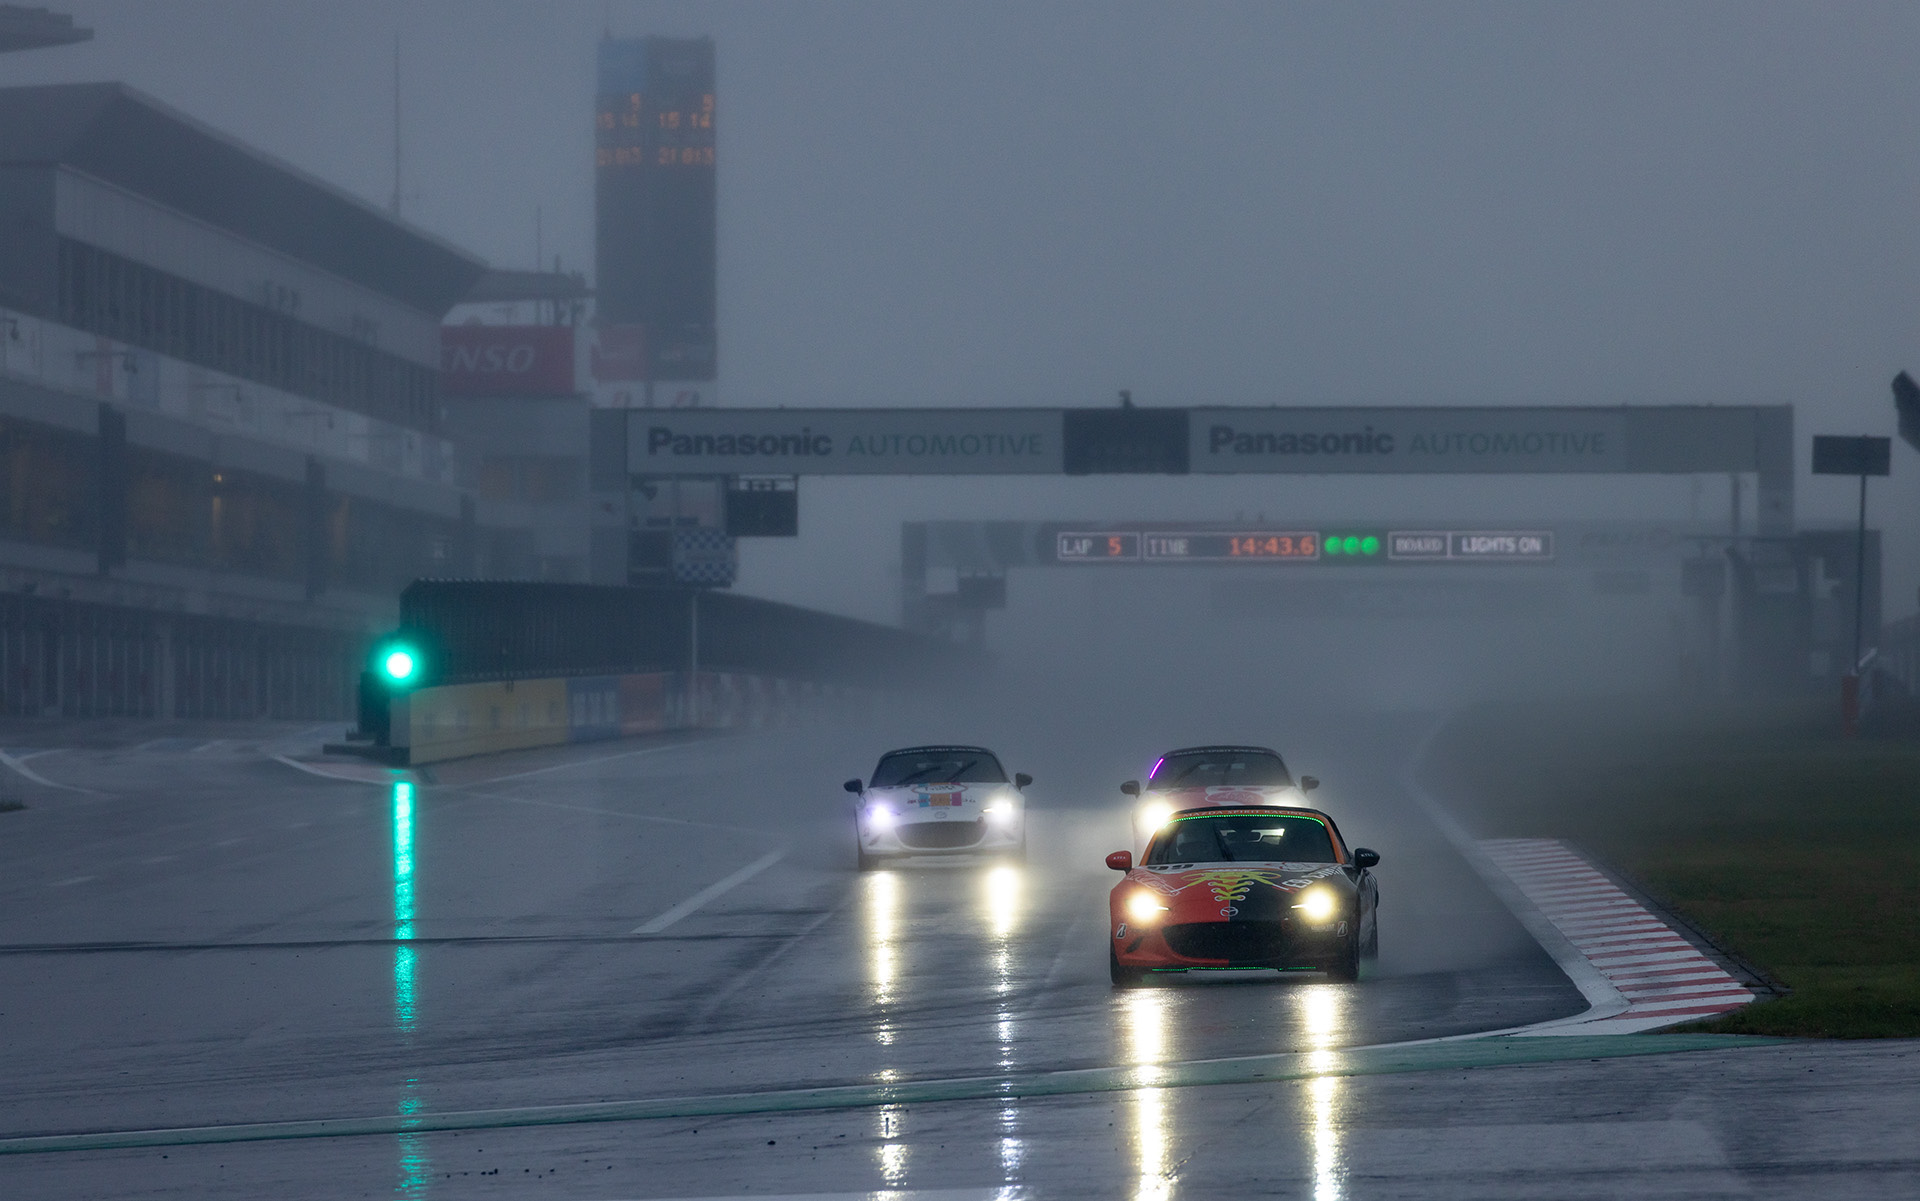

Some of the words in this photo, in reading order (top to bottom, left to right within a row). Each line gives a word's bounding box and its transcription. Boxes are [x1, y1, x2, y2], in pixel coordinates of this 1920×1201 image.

[648, 427, 832, 456] Panasonic
[846, 434, 1042, 457] AUTOMOTIVE
[1209, 425, 1395, 454] Panasonic
[1408, 432, 1605, 456] AUTOMOTIVE
[1062, 538, 1092, 555] LAP
[1108, 536, 1122, 556] 5
[1150, 538, 1189, 555] TIME
[1230, 536, 1315, 556] 14:43.6
[1461, 536, 1516, 553] LIGHTS
[1518, 536, 1542, 553] ON
